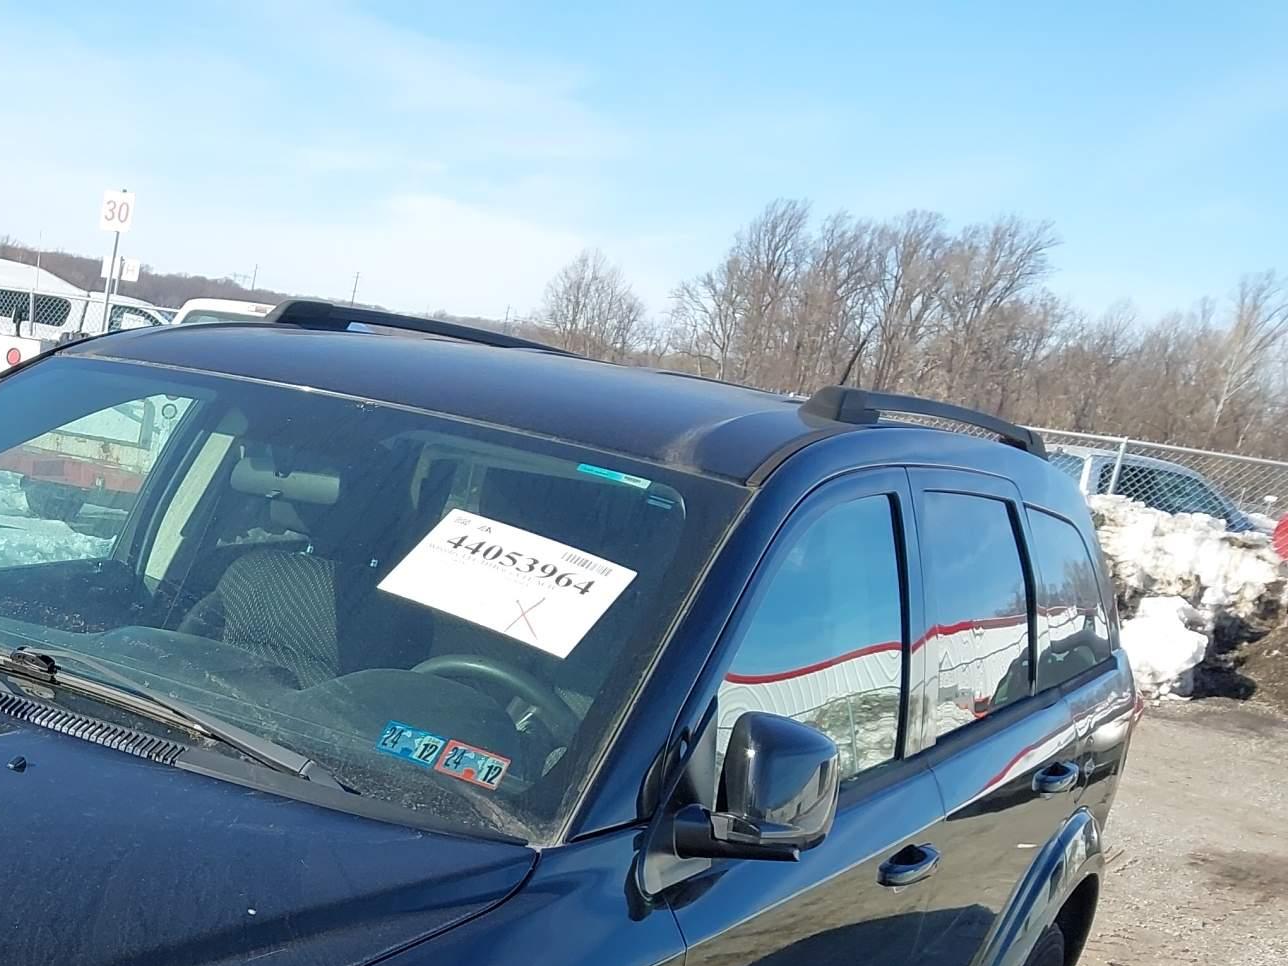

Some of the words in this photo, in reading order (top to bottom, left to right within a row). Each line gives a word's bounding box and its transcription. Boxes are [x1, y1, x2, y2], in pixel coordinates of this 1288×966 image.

[104, 199, 130, 223] 30
[446, 535, 596, 596] 44053964
[381, 726, 405, 749] 24
[417, 743, 439, 762] 12
[443, 746, 467, 770] 24
[481, 764, 503, 785] 12
